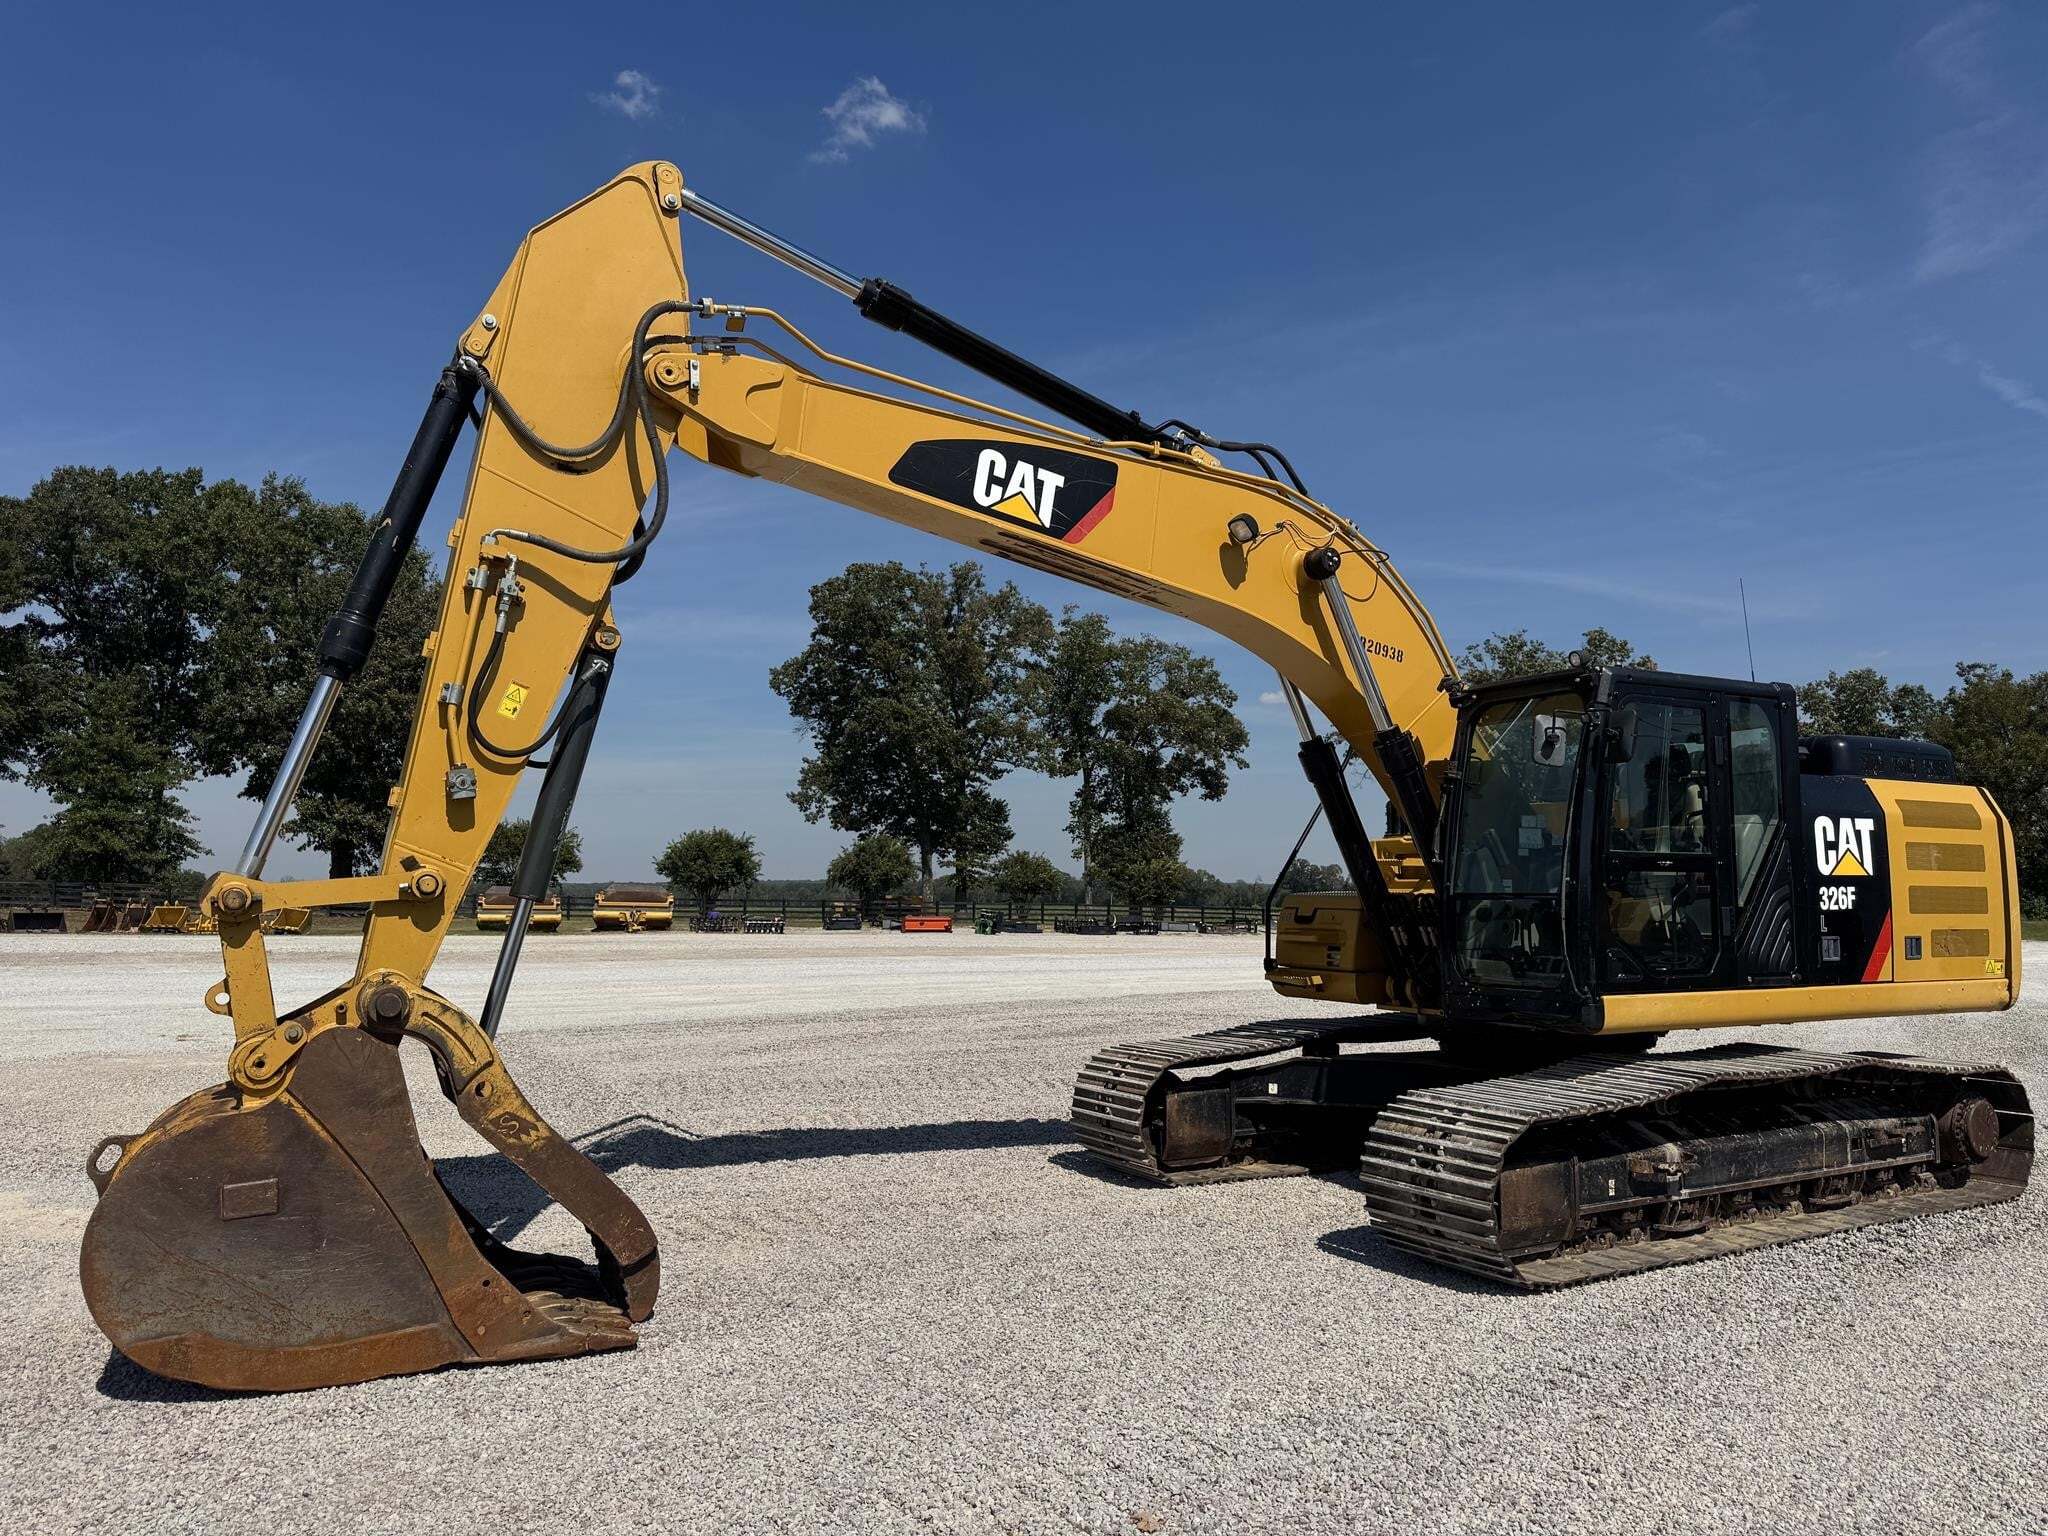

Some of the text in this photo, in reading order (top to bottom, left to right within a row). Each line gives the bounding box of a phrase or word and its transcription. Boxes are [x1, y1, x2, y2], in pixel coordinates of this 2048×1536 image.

[973, 448, 1065, 528] CAT
[1814, 815, 1874, 876] CAT
[1819, 886, 1856, 910] 326F
[1820, 914, 1828, 933] L
